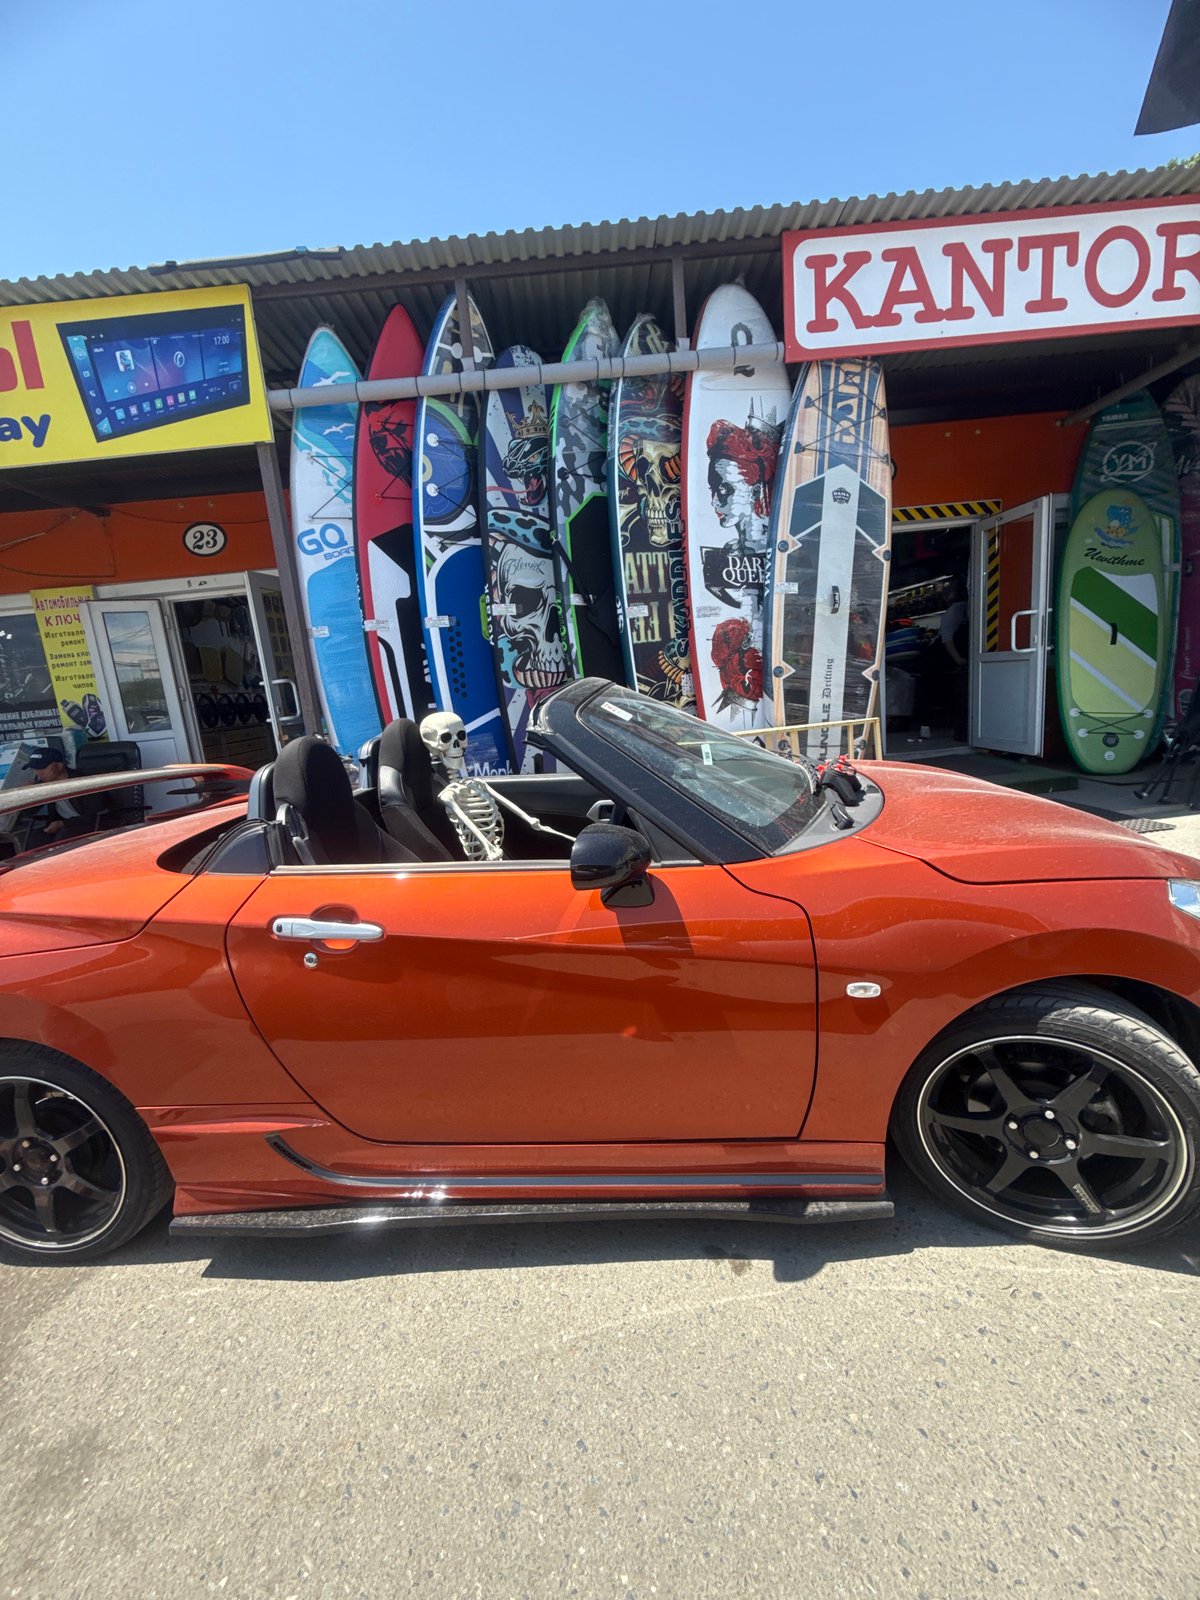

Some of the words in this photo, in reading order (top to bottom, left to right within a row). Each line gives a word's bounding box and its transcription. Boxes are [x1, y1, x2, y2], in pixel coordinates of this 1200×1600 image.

[805, 221, 1200, 335] KANTOR
[213, 334, 230, 345] 17:00
[193, 529, 218, 550] 23
[727, 555, 766, 571] DAR
[1084, 547, 1145, 566] Uwithme
[61, 638, 85, 648] ремонт
[49, 652, 75, 660] Замена
[51, 661, 77, 670] ремонт
